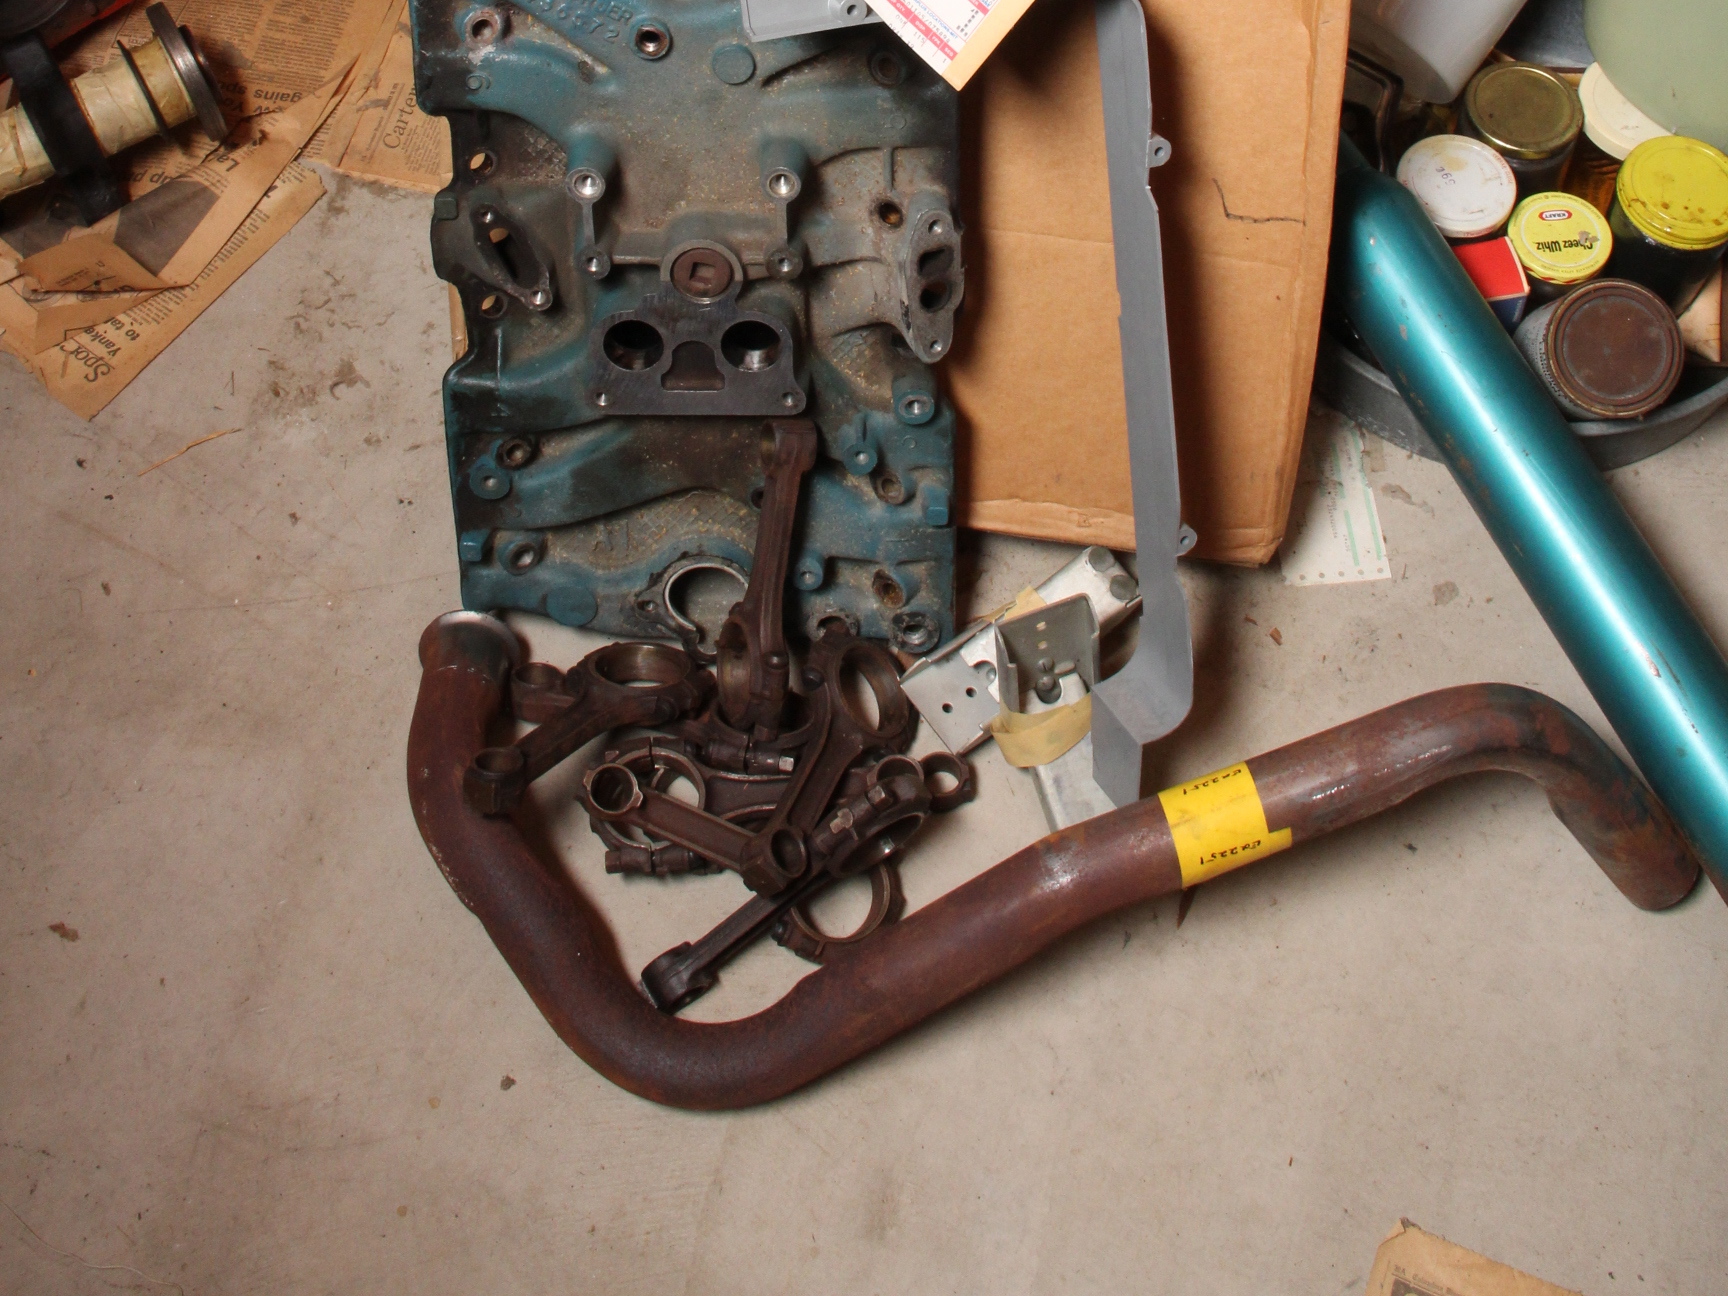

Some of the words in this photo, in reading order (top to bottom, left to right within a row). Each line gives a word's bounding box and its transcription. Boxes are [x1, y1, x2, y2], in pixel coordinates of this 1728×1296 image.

[253, 84, 301, 107] gains
[1535, 239, 1561, 252] Whiz
[123, 326, 140, 343] to
